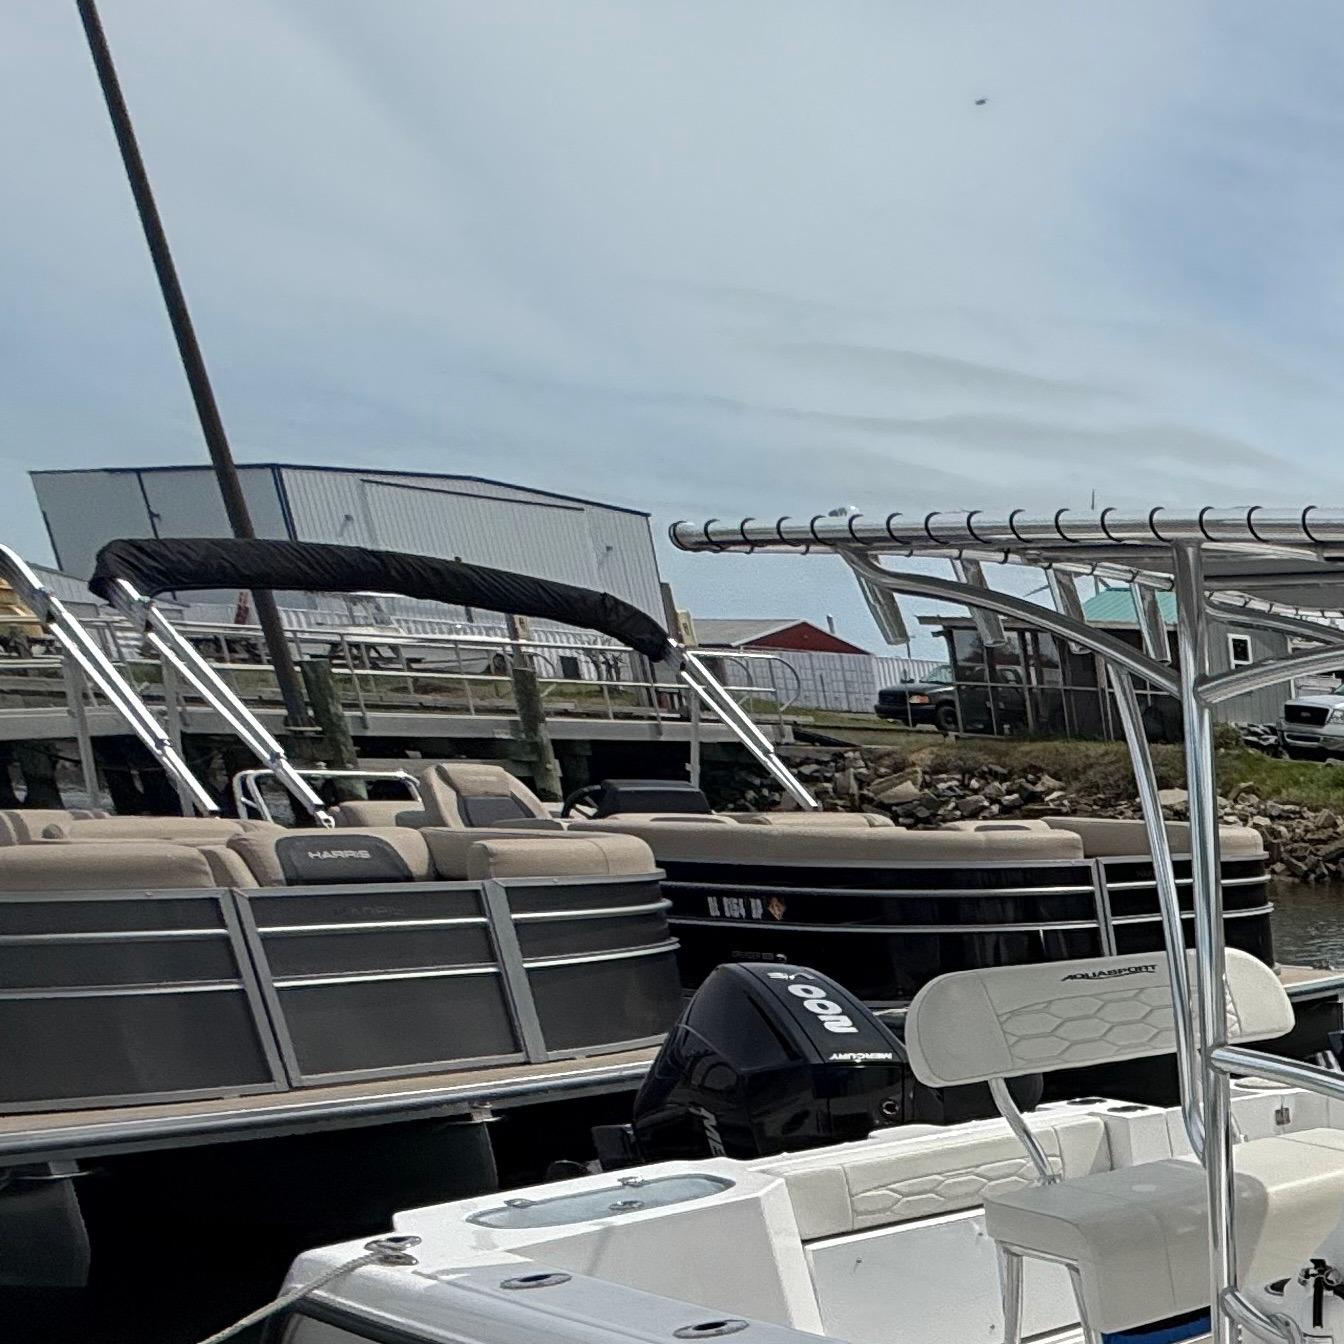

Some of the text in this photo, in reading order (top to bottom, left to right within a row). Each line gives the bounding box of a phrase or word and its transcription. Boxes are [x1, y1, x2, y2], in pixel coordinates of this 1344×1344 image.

[307, 849, 372, 860] HARRIS
[1061, 963, 1159, 982] AQUASPORT
[787, 983, 860, 1034] 200
[828, 1052, 893, 1062] MERCURY
